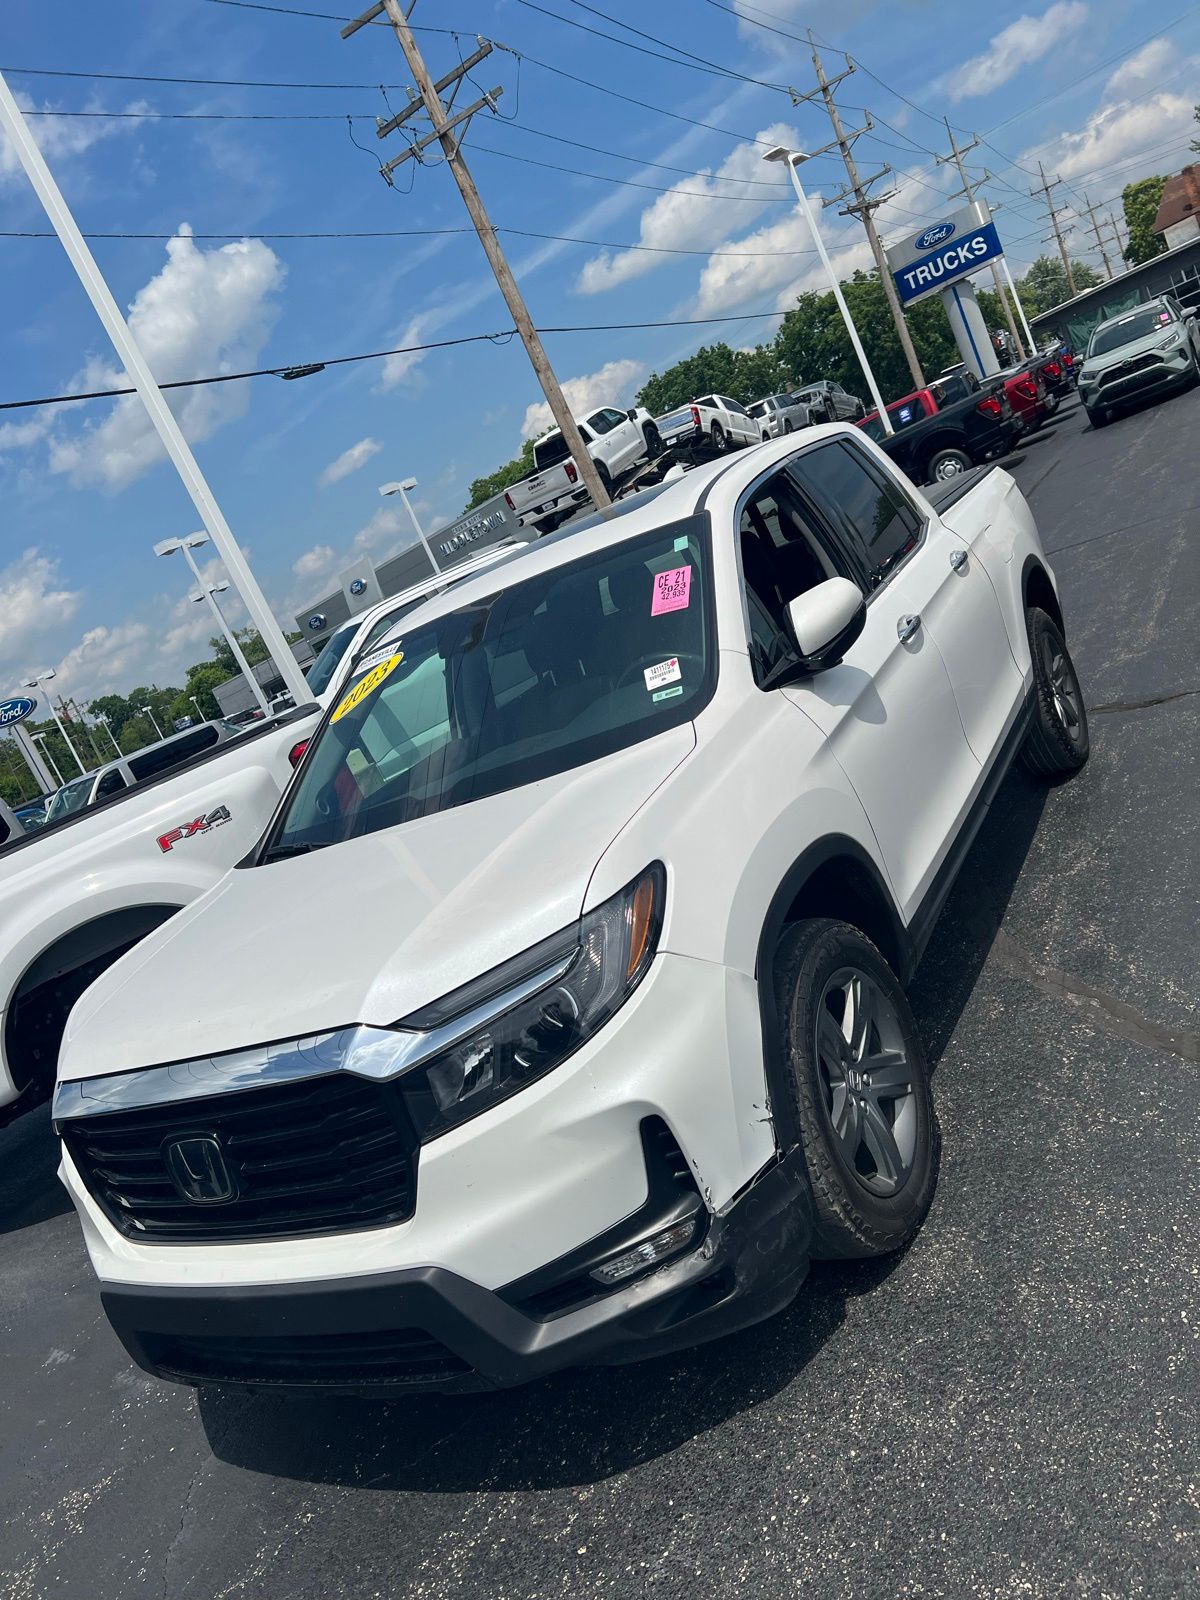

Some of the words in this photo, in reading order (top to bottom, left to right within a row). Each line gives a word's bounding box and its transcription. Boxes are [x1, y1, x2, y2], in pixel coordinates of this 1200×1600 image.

[922, 227, 947, 246] Ford
[904, 237, 988, 289] TRUCKS
[528, 480, 546, 491] GMC
[440, 511, 506, 556] MIDDLETOWN
[658, 573, 670, 589] CE
[675, 571, 686, 584] 21
[660, 582, 687, 595] 2023
[341, 660, 391, 715] 2023
[156, 805, 231, 853] FX4
[201, 827, 214, 835] OFF
[216, 817, 233, 828] ROAD
